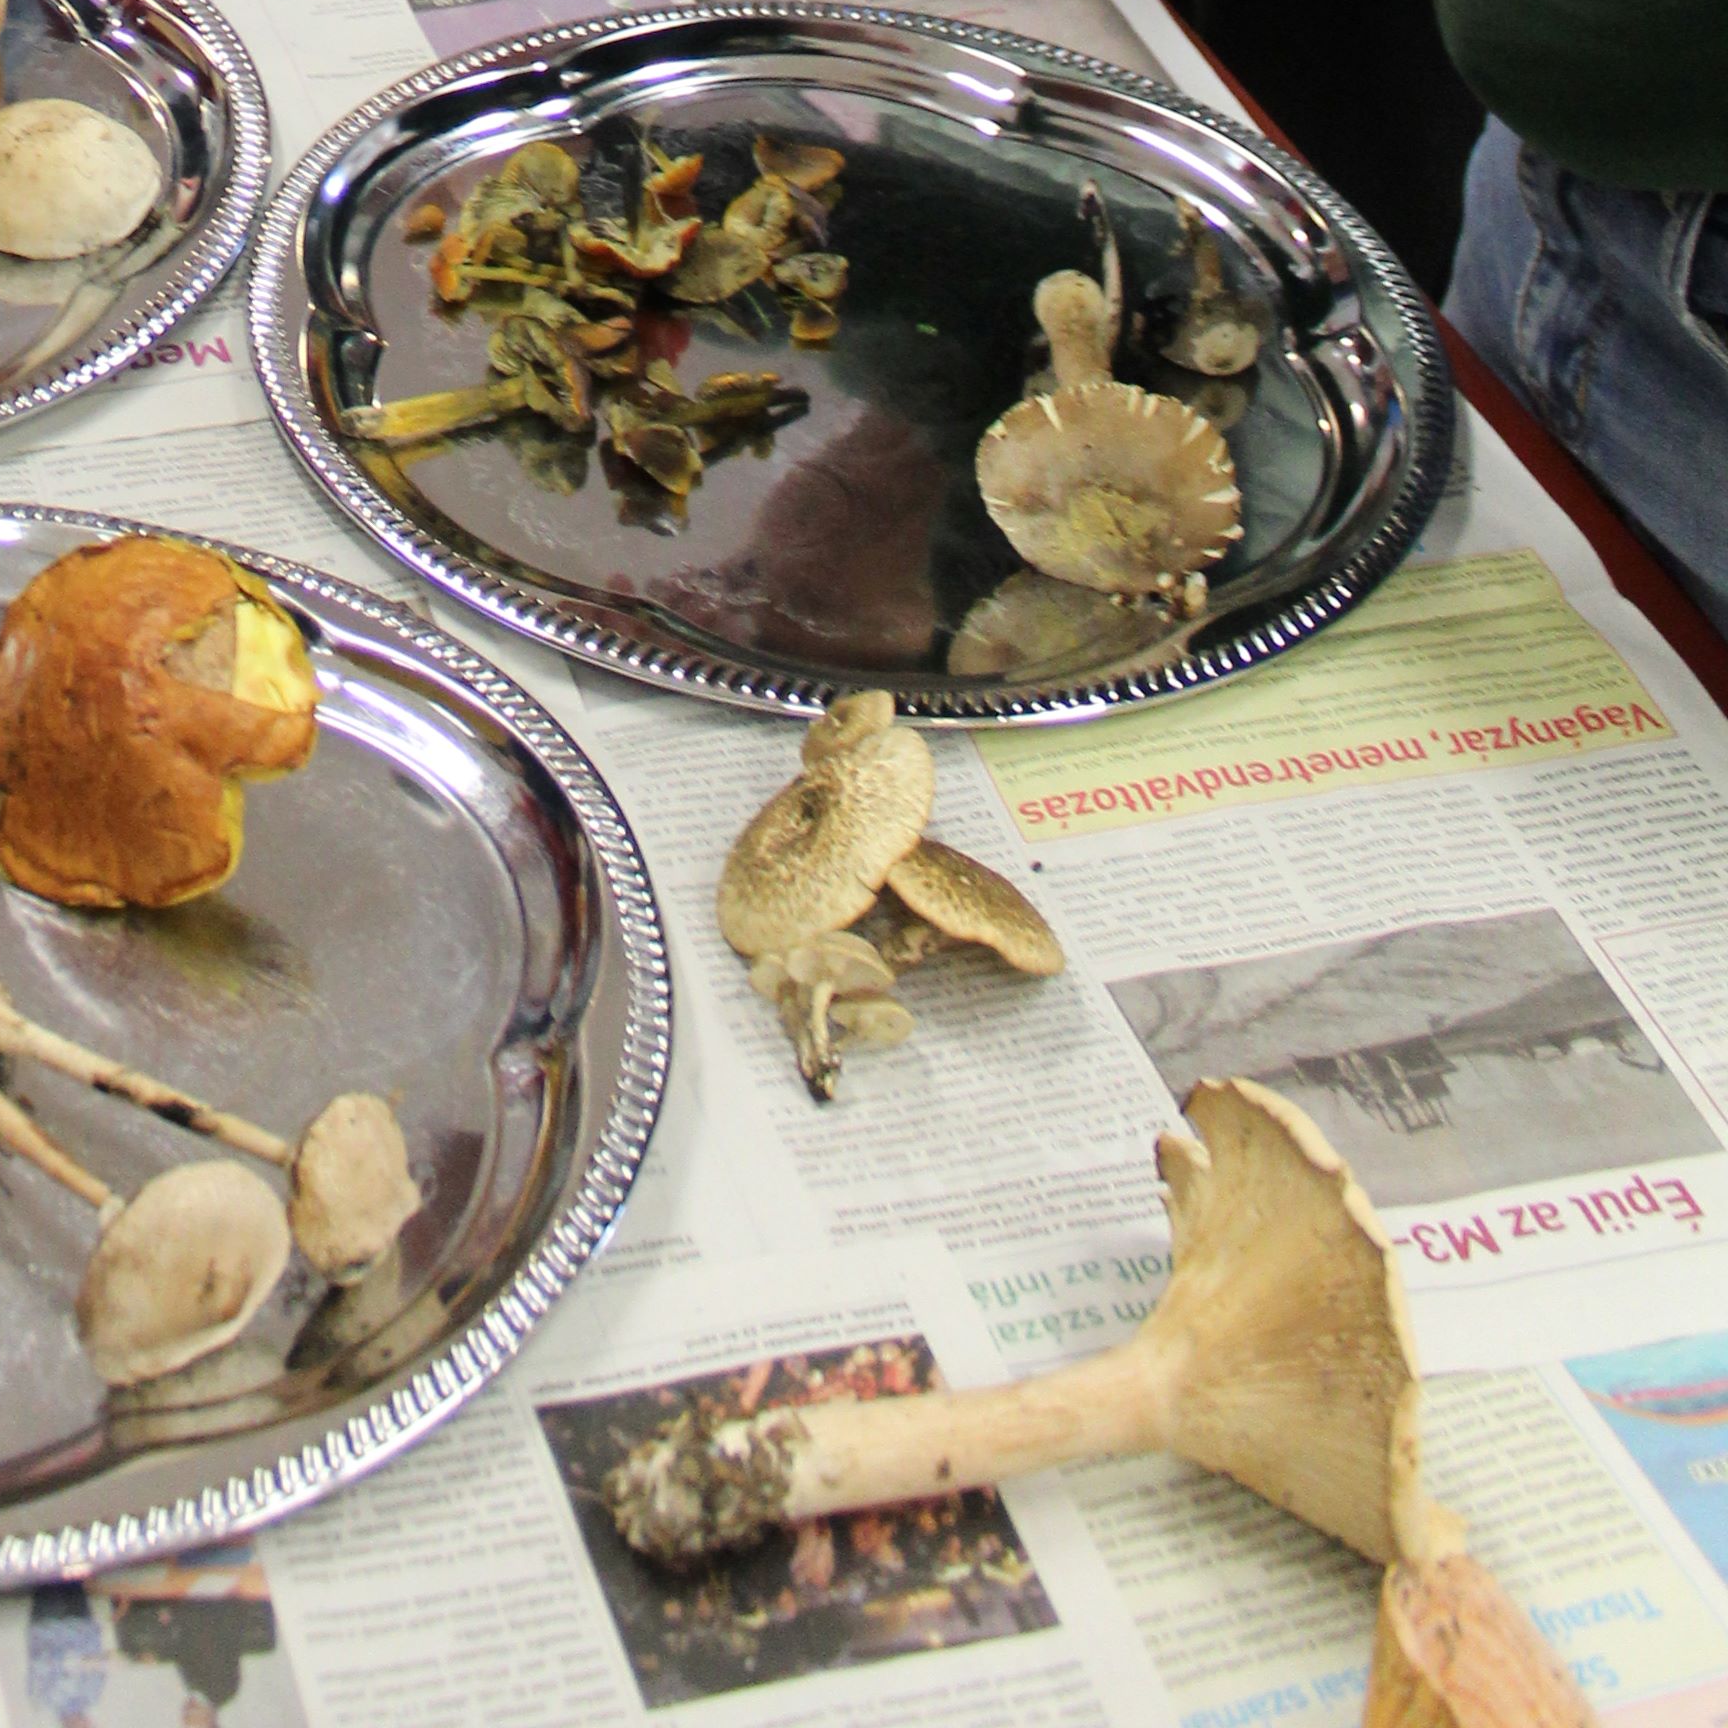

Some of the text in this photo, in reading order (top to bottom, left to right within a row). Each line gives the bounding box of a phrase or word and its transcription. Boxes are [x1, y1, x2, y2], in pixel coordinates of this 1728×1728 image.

[1017, 702, 1663, 830] Vágányzár, menetrendváltozás
[1392, 1174, 1704, 1264] Épül az M3-
[1057, 1259, 1101, 1286] az
